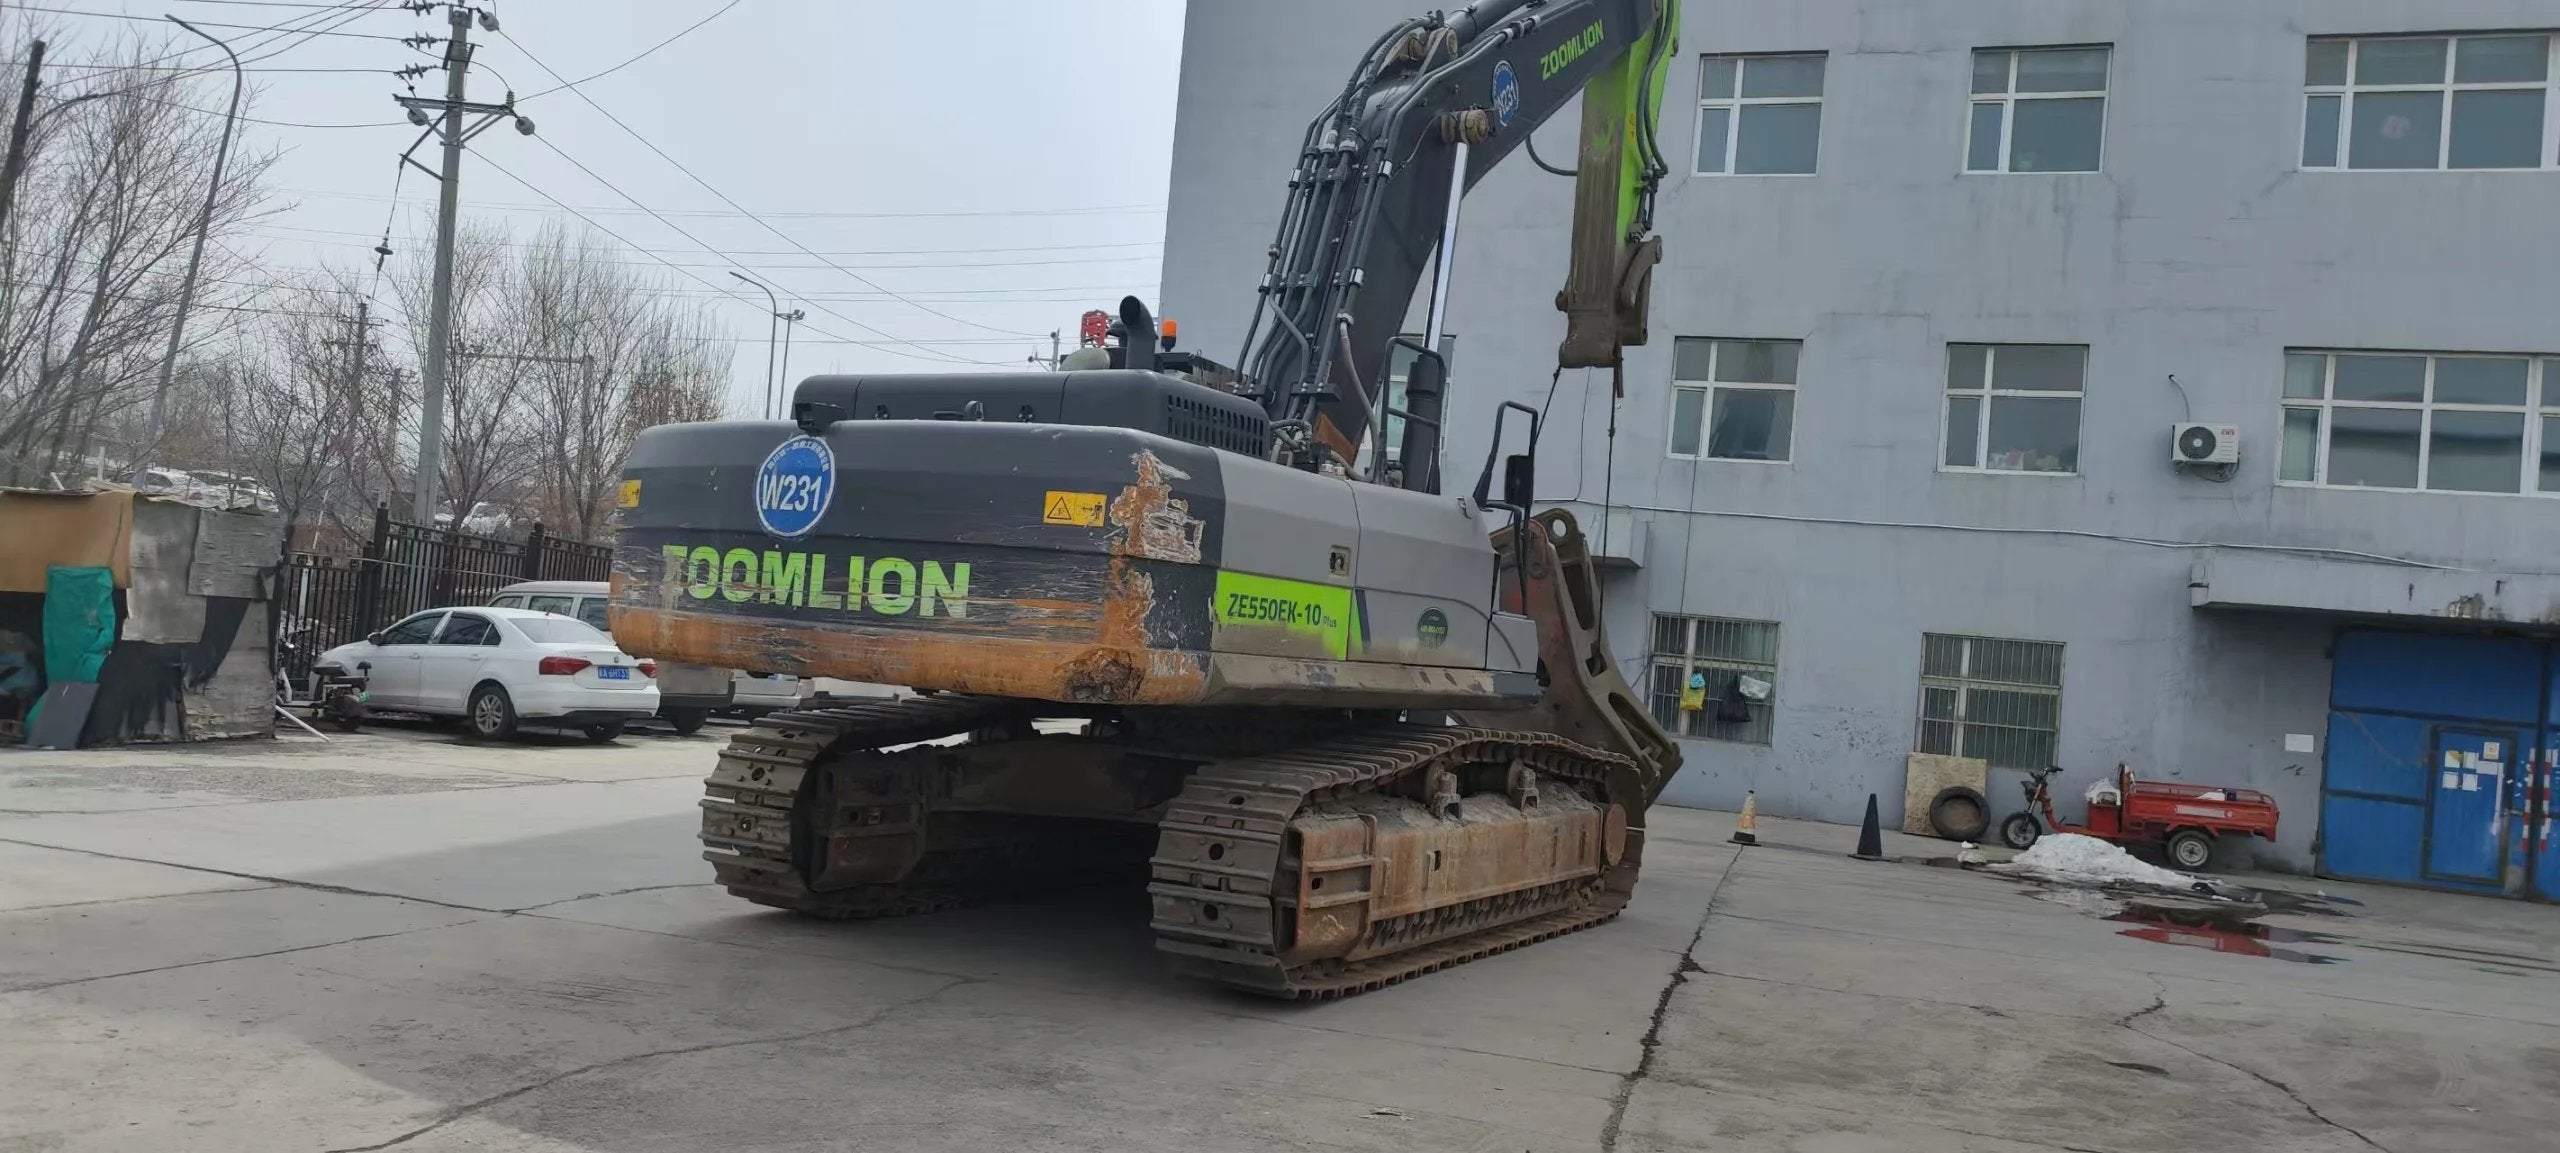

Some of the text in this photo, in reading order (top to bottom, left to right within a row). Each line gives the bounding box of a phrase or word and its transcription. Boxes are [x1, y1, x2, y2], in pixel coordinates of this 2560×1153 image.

[1540, 19, 1604, 80] ZOOMLION
[762, 474, 823, 512] W231
[1227, 593, 1322, 626] ZE550EK-10
